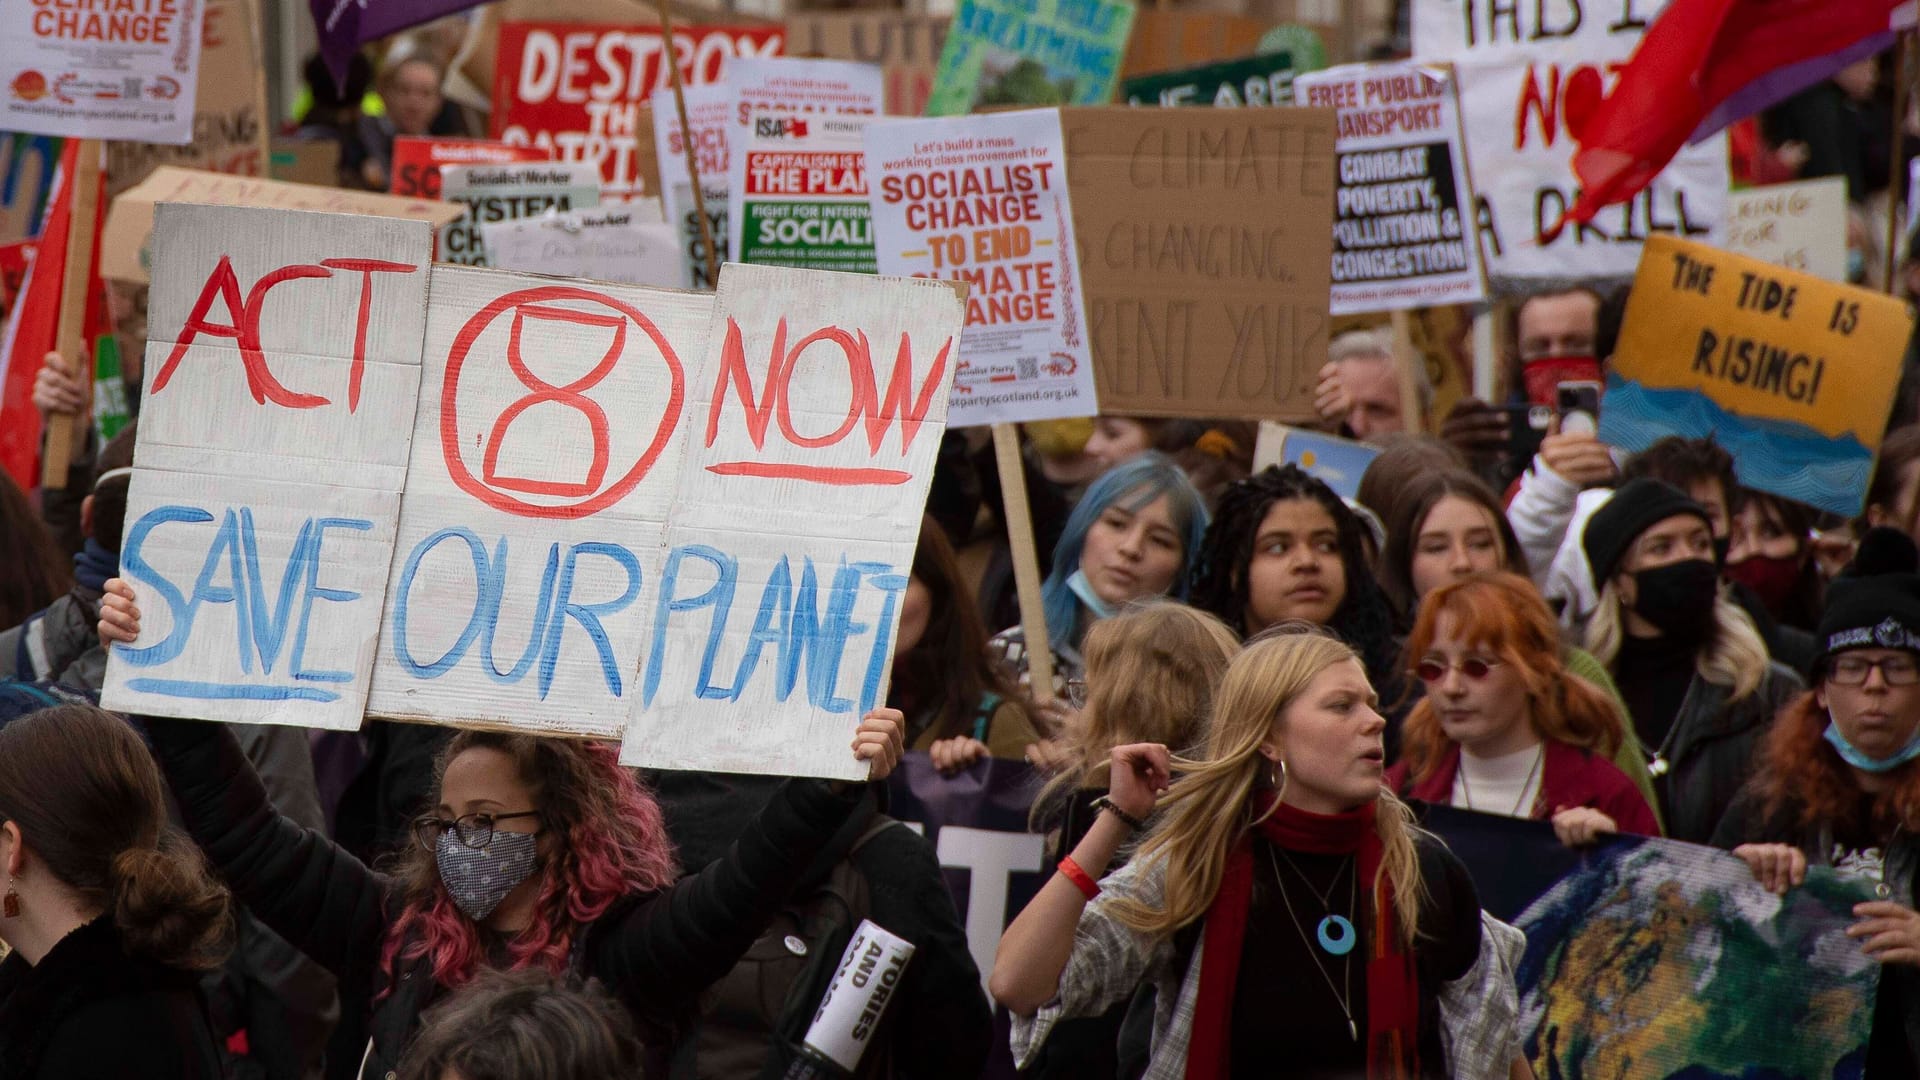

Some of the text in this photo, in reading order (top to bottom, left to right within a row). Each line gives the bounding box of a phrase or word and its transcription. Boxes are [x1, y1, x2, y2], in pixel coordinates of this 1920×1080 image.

[32, 10, 172, 43] CHANGE
[1308, 80, 1358, 109] FREE
[755, 117, 785, 138] ISA
[1335, 103, 1442, 141] ANSPORT
[751, 154, 837, 169] CAPITALISM
[882, 146, 1048, 170] working class movement for
[914, 141, 942, 155] Let's
[945, 138, 973, 152] build
[985, 137, 1014, 148] mass
[1129, 124, 1329, 199] CLIMATE
[1339, 146, 1430, 186] COMBAT
[751, 169, 802, 193] THE
[881, 162, 1053, 204] SOCIALIST
[1337, 177, 1441, 218] POVERTY,
[752, 204, 790, 218] FIGHT
[793, 204, 818, 218] FOR
[758, 217, 873, 245] SOCIALI
[906, 193, 1042, 231] CHANGE
[1441, 207, 1460, 238] &
[1533, 186, 1711, 246] DRILL
[927, 234, 966, 269] TO
[973, 225, 1032, 263] END
[1331, 240, 1468, 282] CONGESTION
[911, 262, 1056, 295] MATE
[1672, 253, 1860, 336] THE TIDE IS
[150, 255, 954, 457] ACT NOW
[1216, 301, 1327, 406] YOU?
[1692, 327, 1826, 407] RISING!
[111, 504, 909, 724] SAVE OUR PLANET
[851, 940, 884, 989] AND
[851, 952, 908, 1042] TORIES
